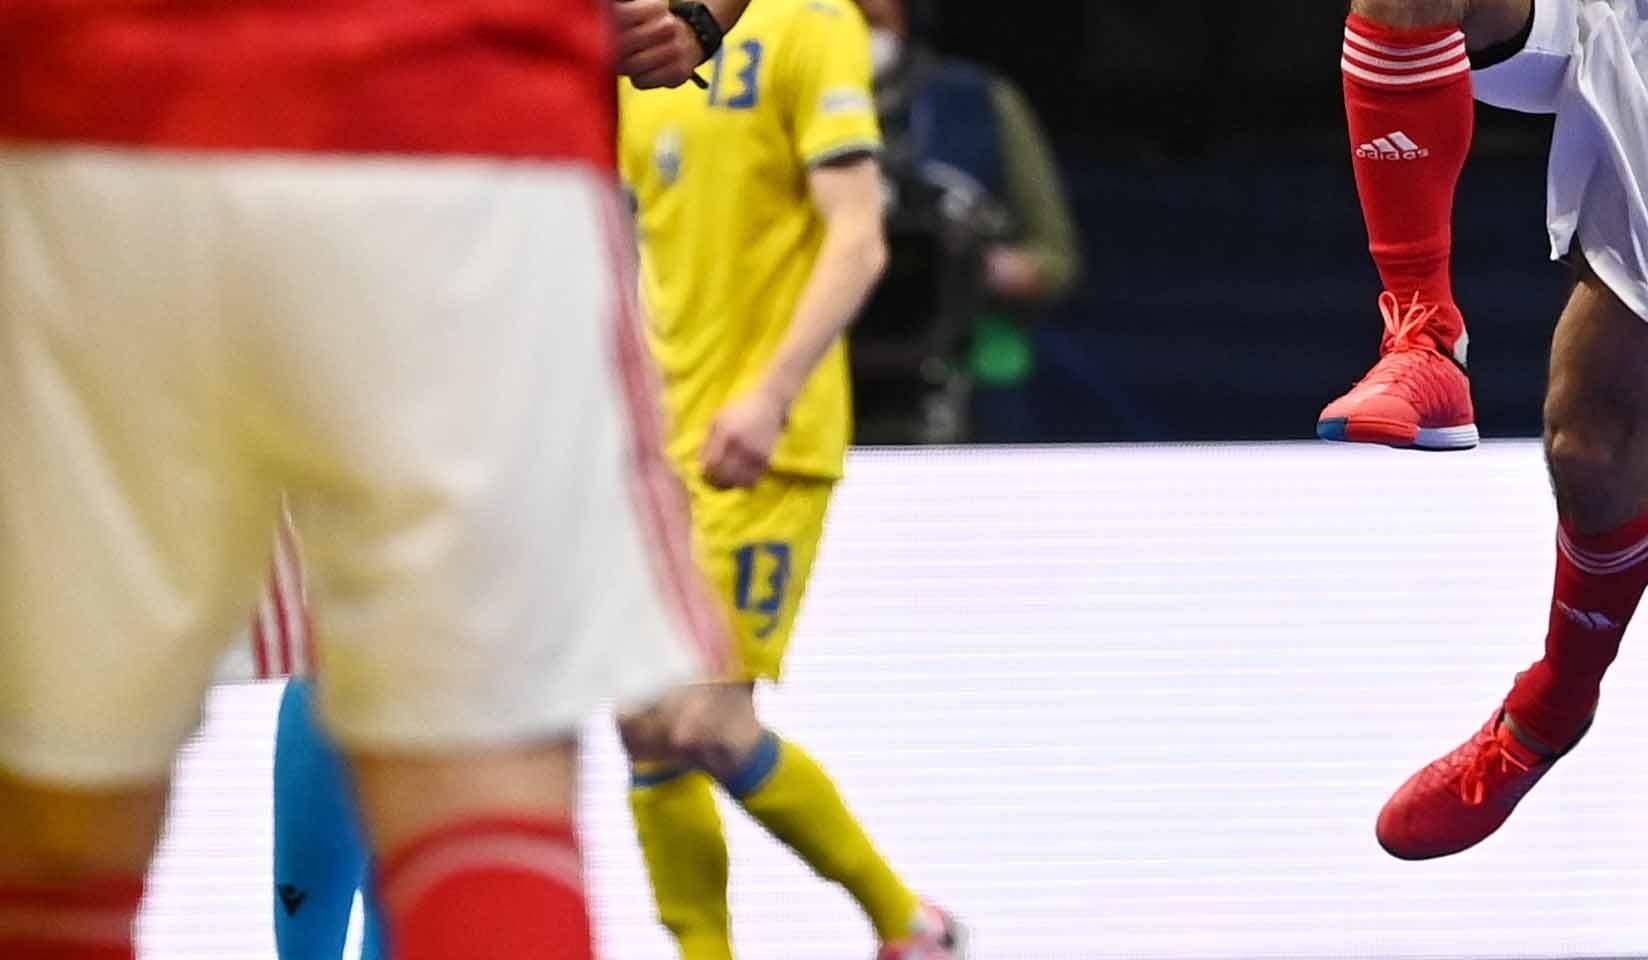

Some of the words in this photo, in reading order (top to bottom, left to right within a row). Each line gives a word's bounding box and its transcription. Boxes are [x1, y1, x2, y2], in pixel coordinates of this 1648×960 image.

[709, 38, 765, 109] 13
[1355, 145, 1429, 160] adidas
[734, 542, 791, 612] 13
